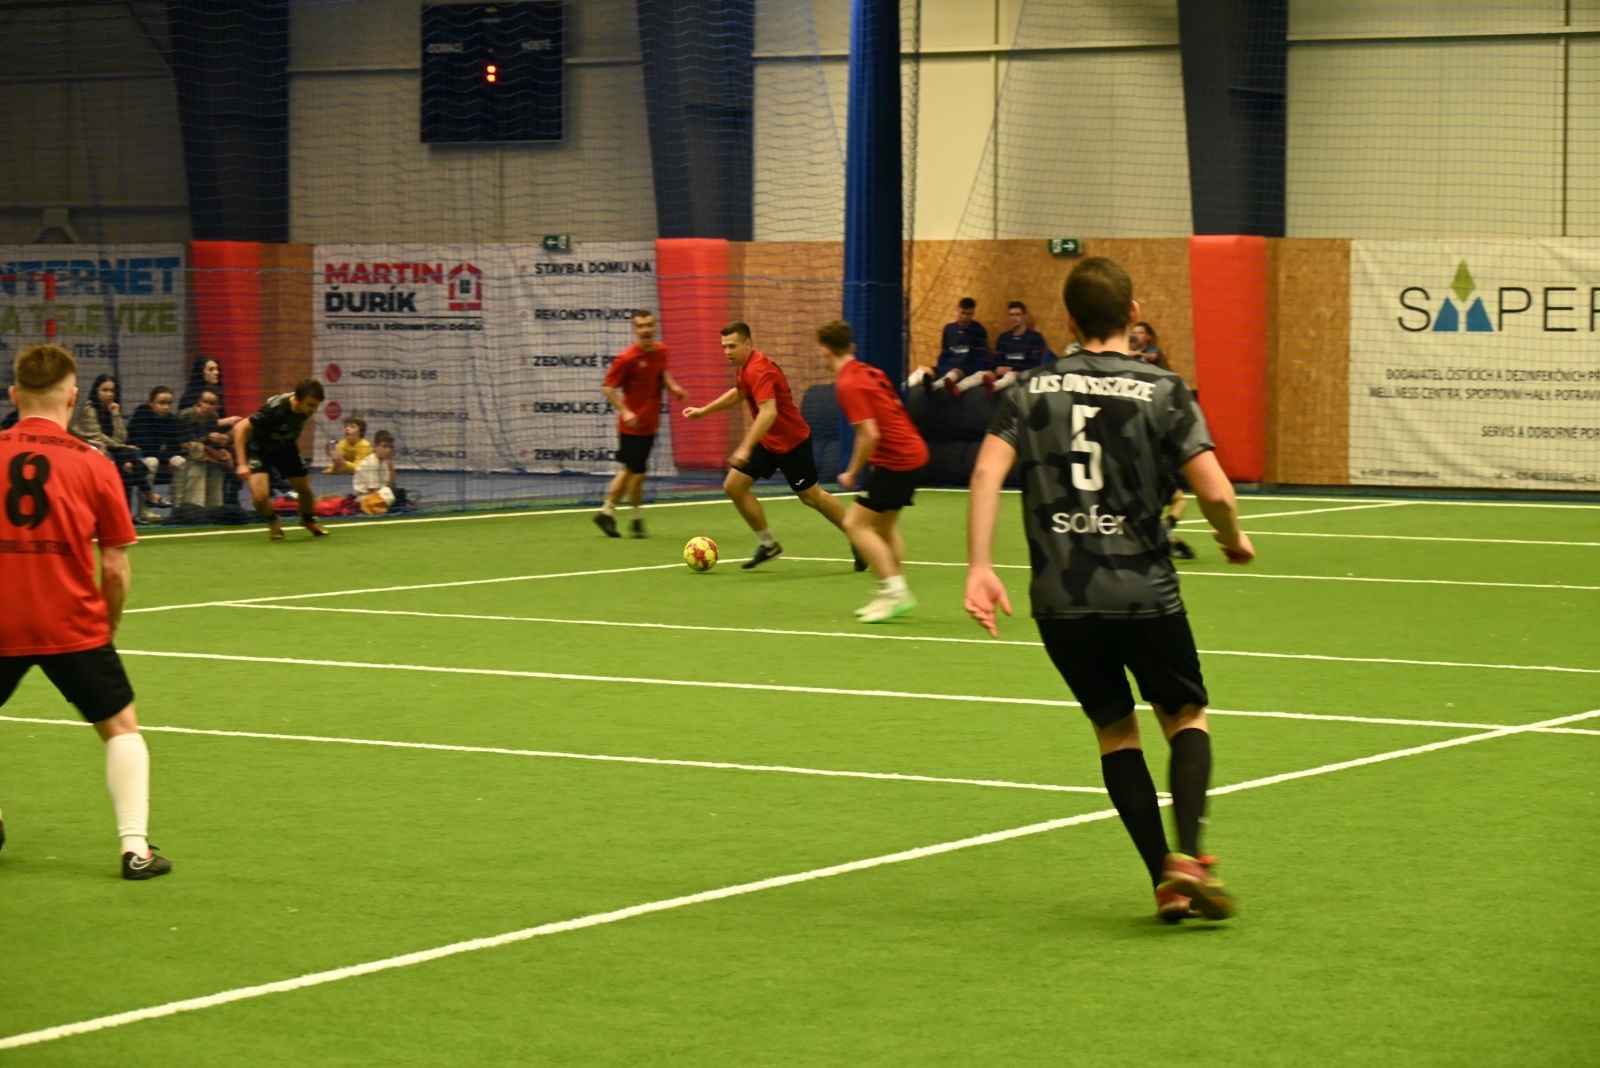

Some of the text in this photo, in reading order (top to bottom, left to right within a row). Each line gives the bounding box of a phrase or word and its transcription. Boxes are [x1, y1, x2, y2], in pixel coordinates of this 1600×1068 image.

[325, 263, 443, 284] MARTIN
[535, 262, 652, 274] STAVBA DOMU NA
[325, 286, 417, 312] ĎURÍK
[535, 309, 636, 320] REKONSTRUKC
[534, 354, 598, 367] ZEDNICKÉ
[1497, 369, 1503, 381] A
[1505, 368, 1586, 382] DEZINFEKČNÍCH
[534, 402, 599, 414] DEMOLICE
[1481, 425, 1516, 438] SERVIS
[1518, 426, 1524, 438] A
[1527, 425, 1578, 439] ODBORNÉ
[534, 447, 578, 460] ZEMNÍ
[1071, 404, 1104, 491] 5
[6, 452, 51, 530] 8
